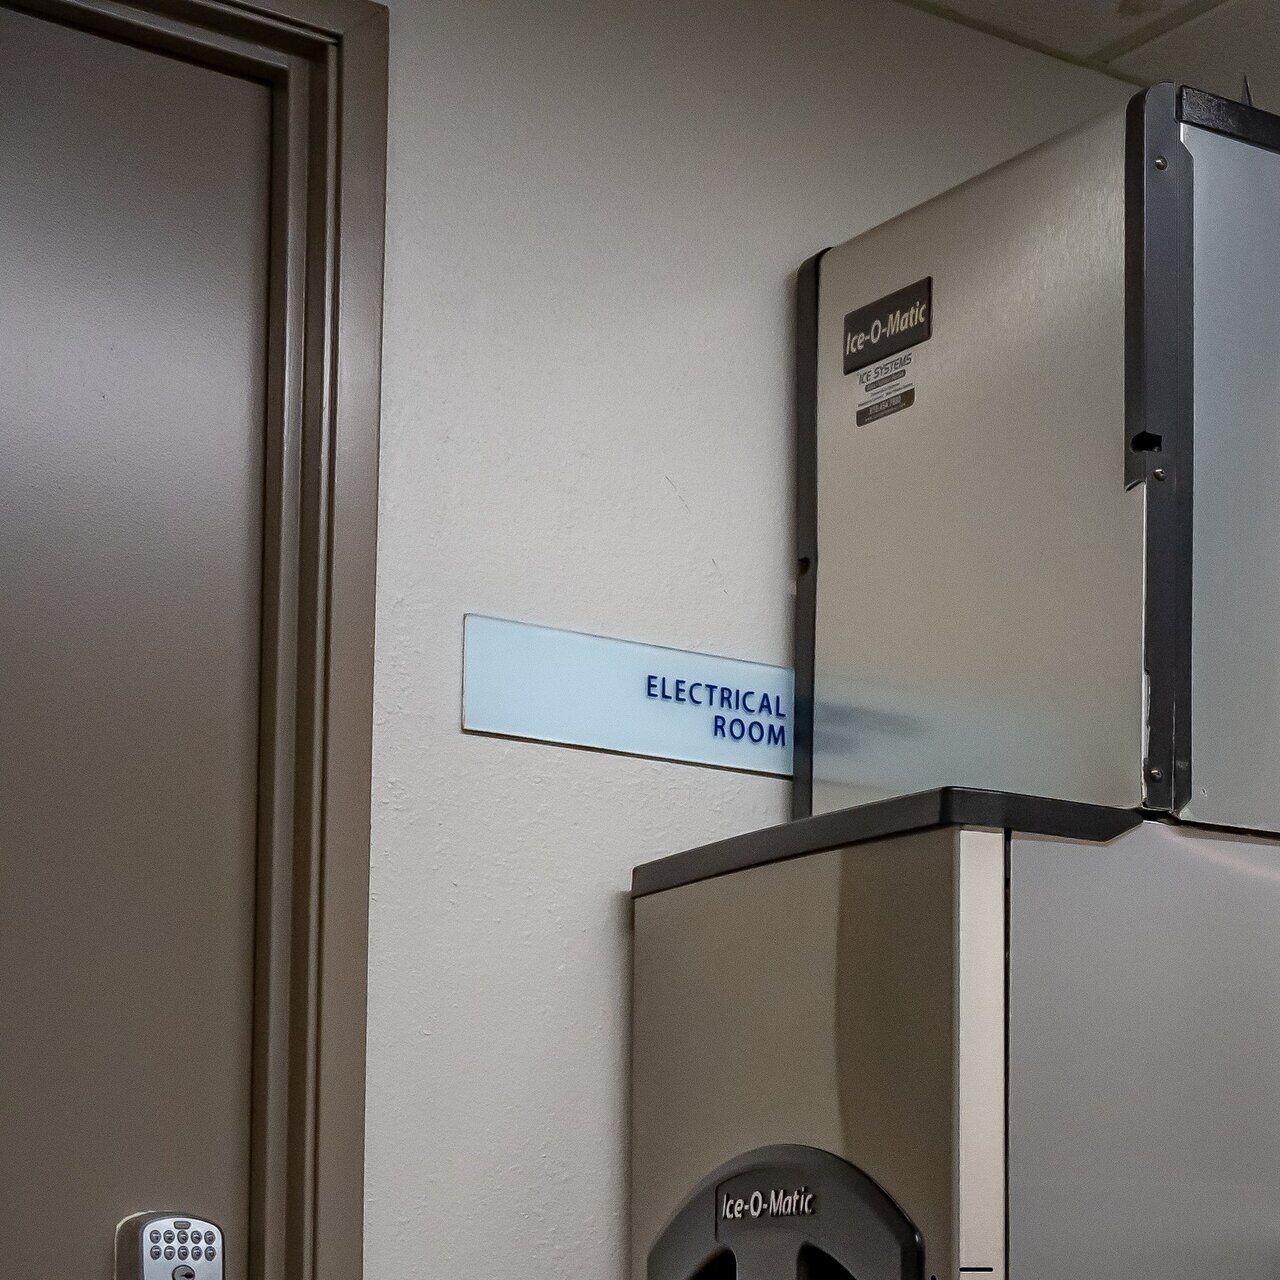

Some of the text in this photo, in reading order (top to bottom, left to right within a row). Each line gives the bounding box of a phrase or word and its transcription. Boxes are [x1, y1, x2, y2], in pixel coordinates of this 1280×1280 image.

[846, 301, 926, 355] Ice-O-Matic
[873, 352, 912, 379] SYSTEMS
[647, 675, 787, 718] ELECTRICAL
[713, 715, 786, 747] ROOM
[722, 1186, 815, 1220] Ice-O-Matic
